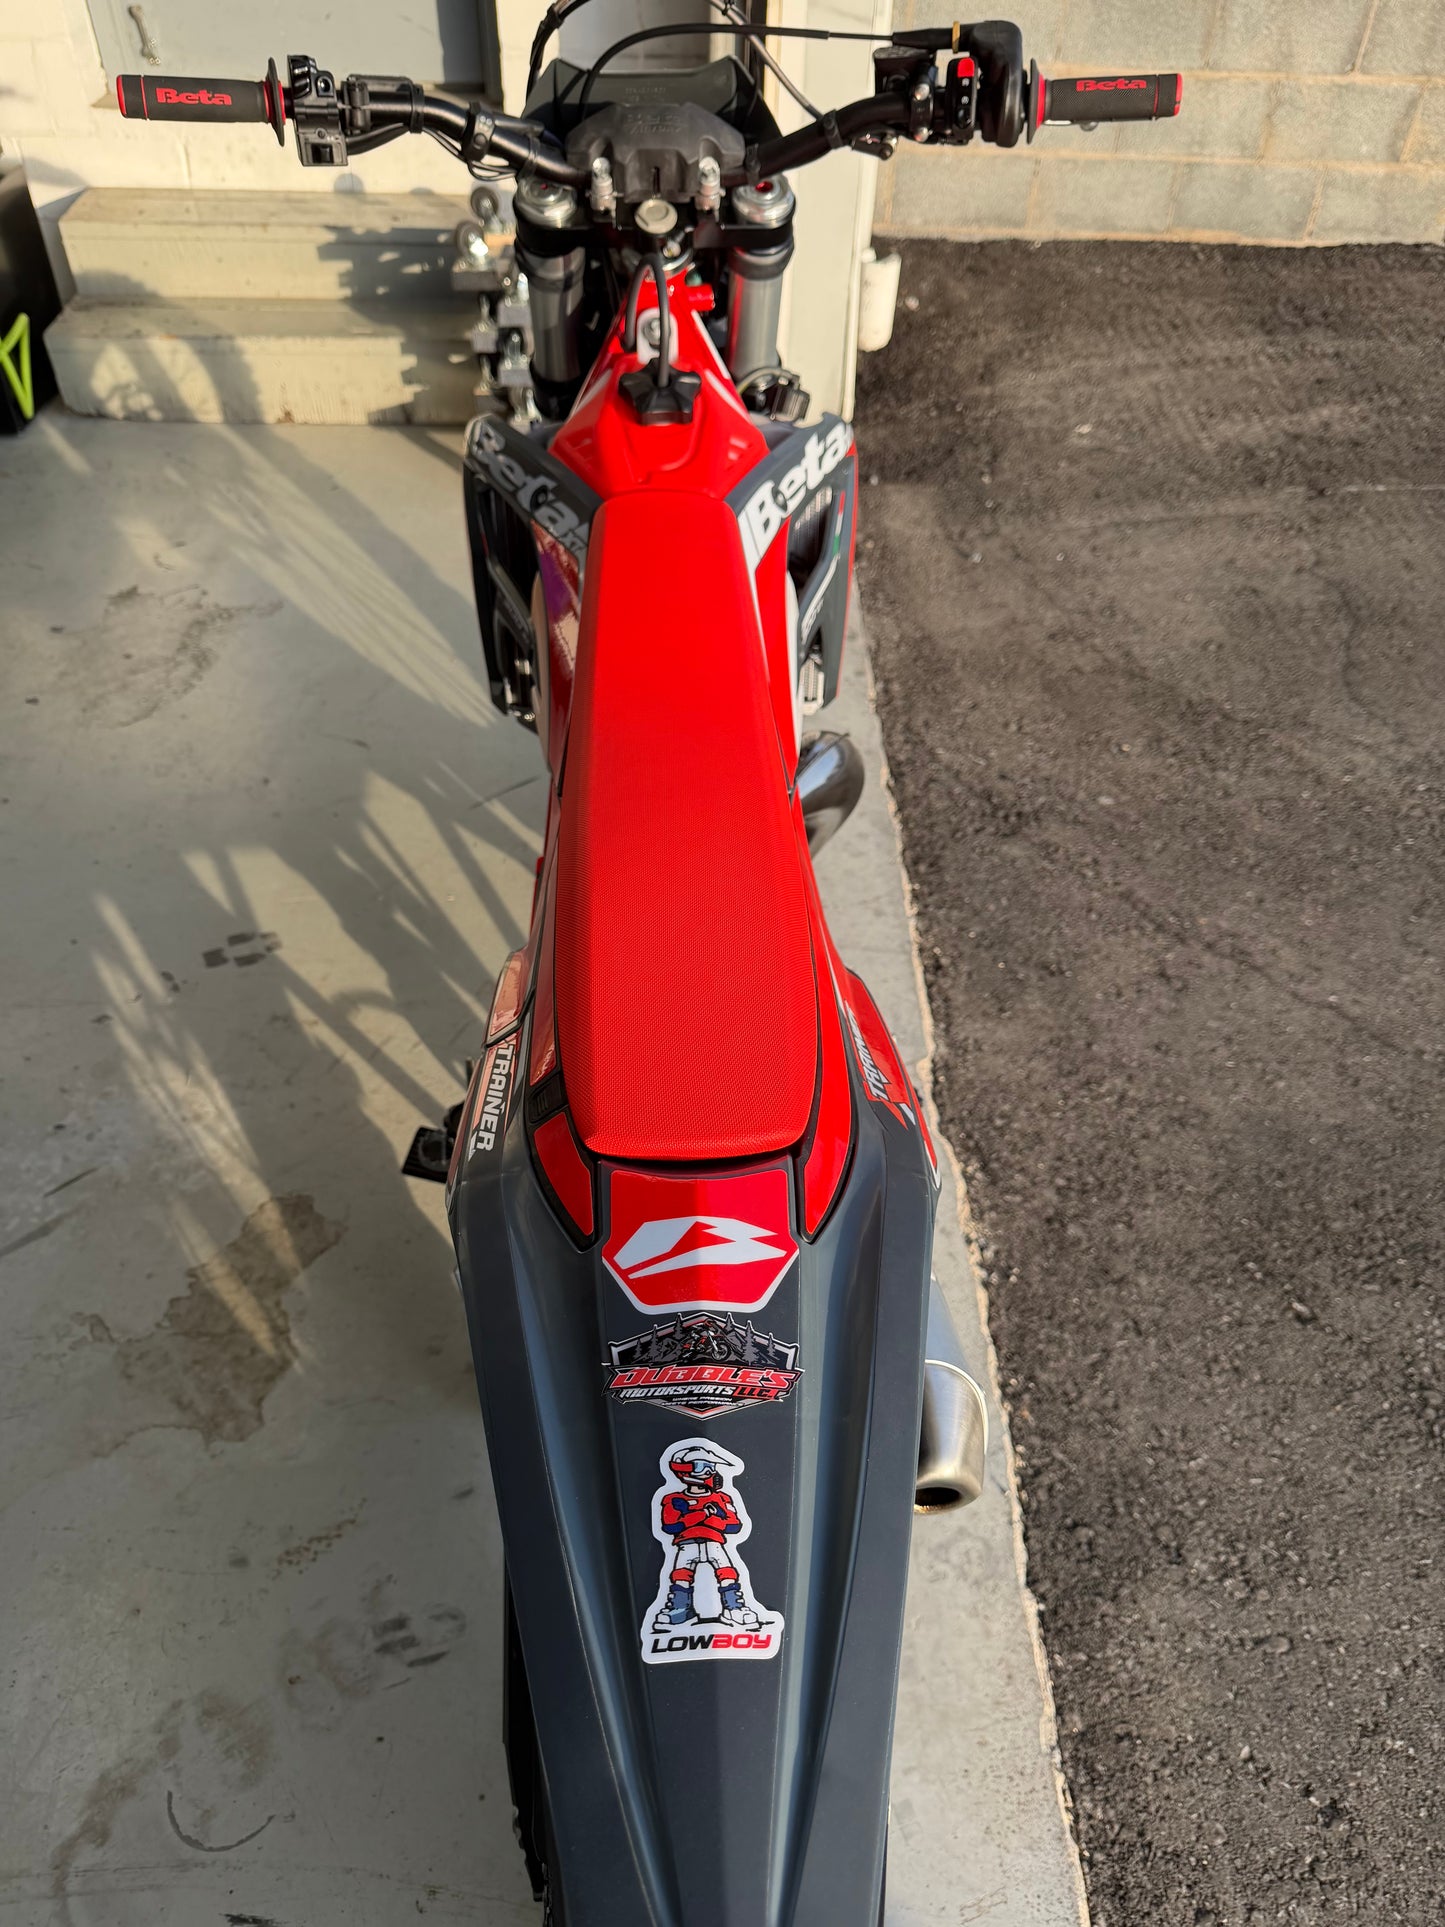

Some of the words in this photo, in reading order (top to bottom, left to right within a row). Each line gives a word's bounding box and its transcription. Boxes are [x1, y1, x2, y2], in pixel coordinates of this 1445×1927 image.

[1075, 78, 1147, 93] Beta
[155, 87, 232, 105] Beta
[471, 420, 580, 538] Beta
[742, 422, 854, 560] Beta
[611, 1365, 797, 1388] DUBBLE'S
[621, 1384, 736, 1398] MOTORSPORTS
[651, 1633, 772, 1653] LOWBOY
